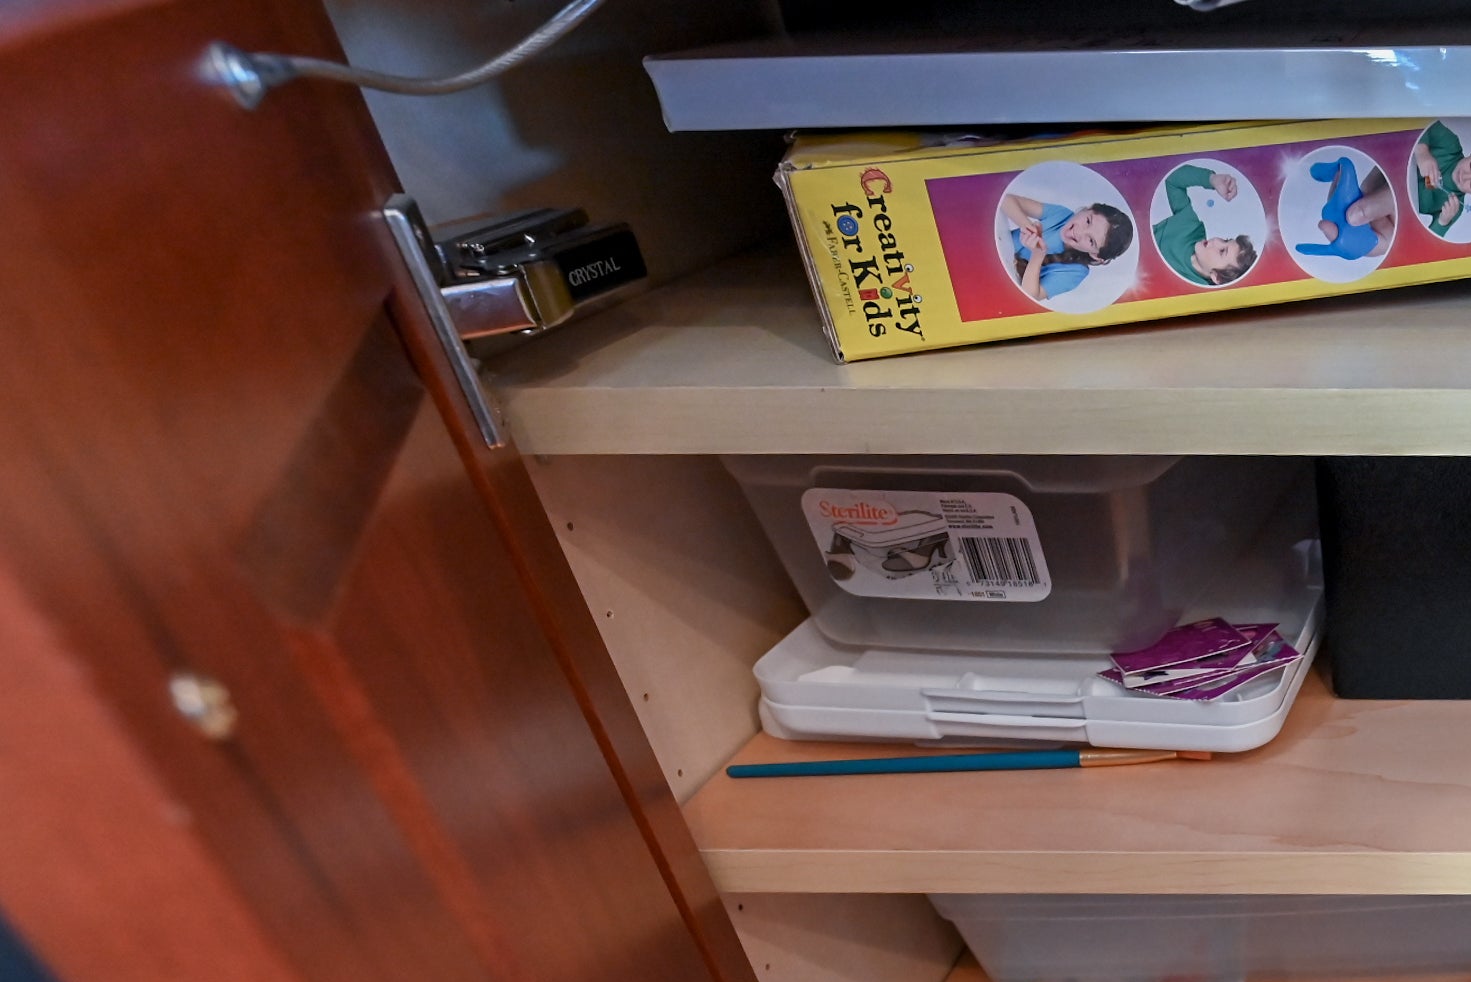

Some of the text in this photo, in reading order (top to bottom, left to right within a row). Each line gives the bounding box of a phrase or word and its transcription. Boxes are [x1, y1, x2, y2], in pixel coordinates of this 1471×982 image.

[568, 257, 621, 287] CRYSTAL
[831, 201, 893, 338] for Kids
[860, 167, 922, 338] Creativity
[819, 500, 887, 520] Sterilite
